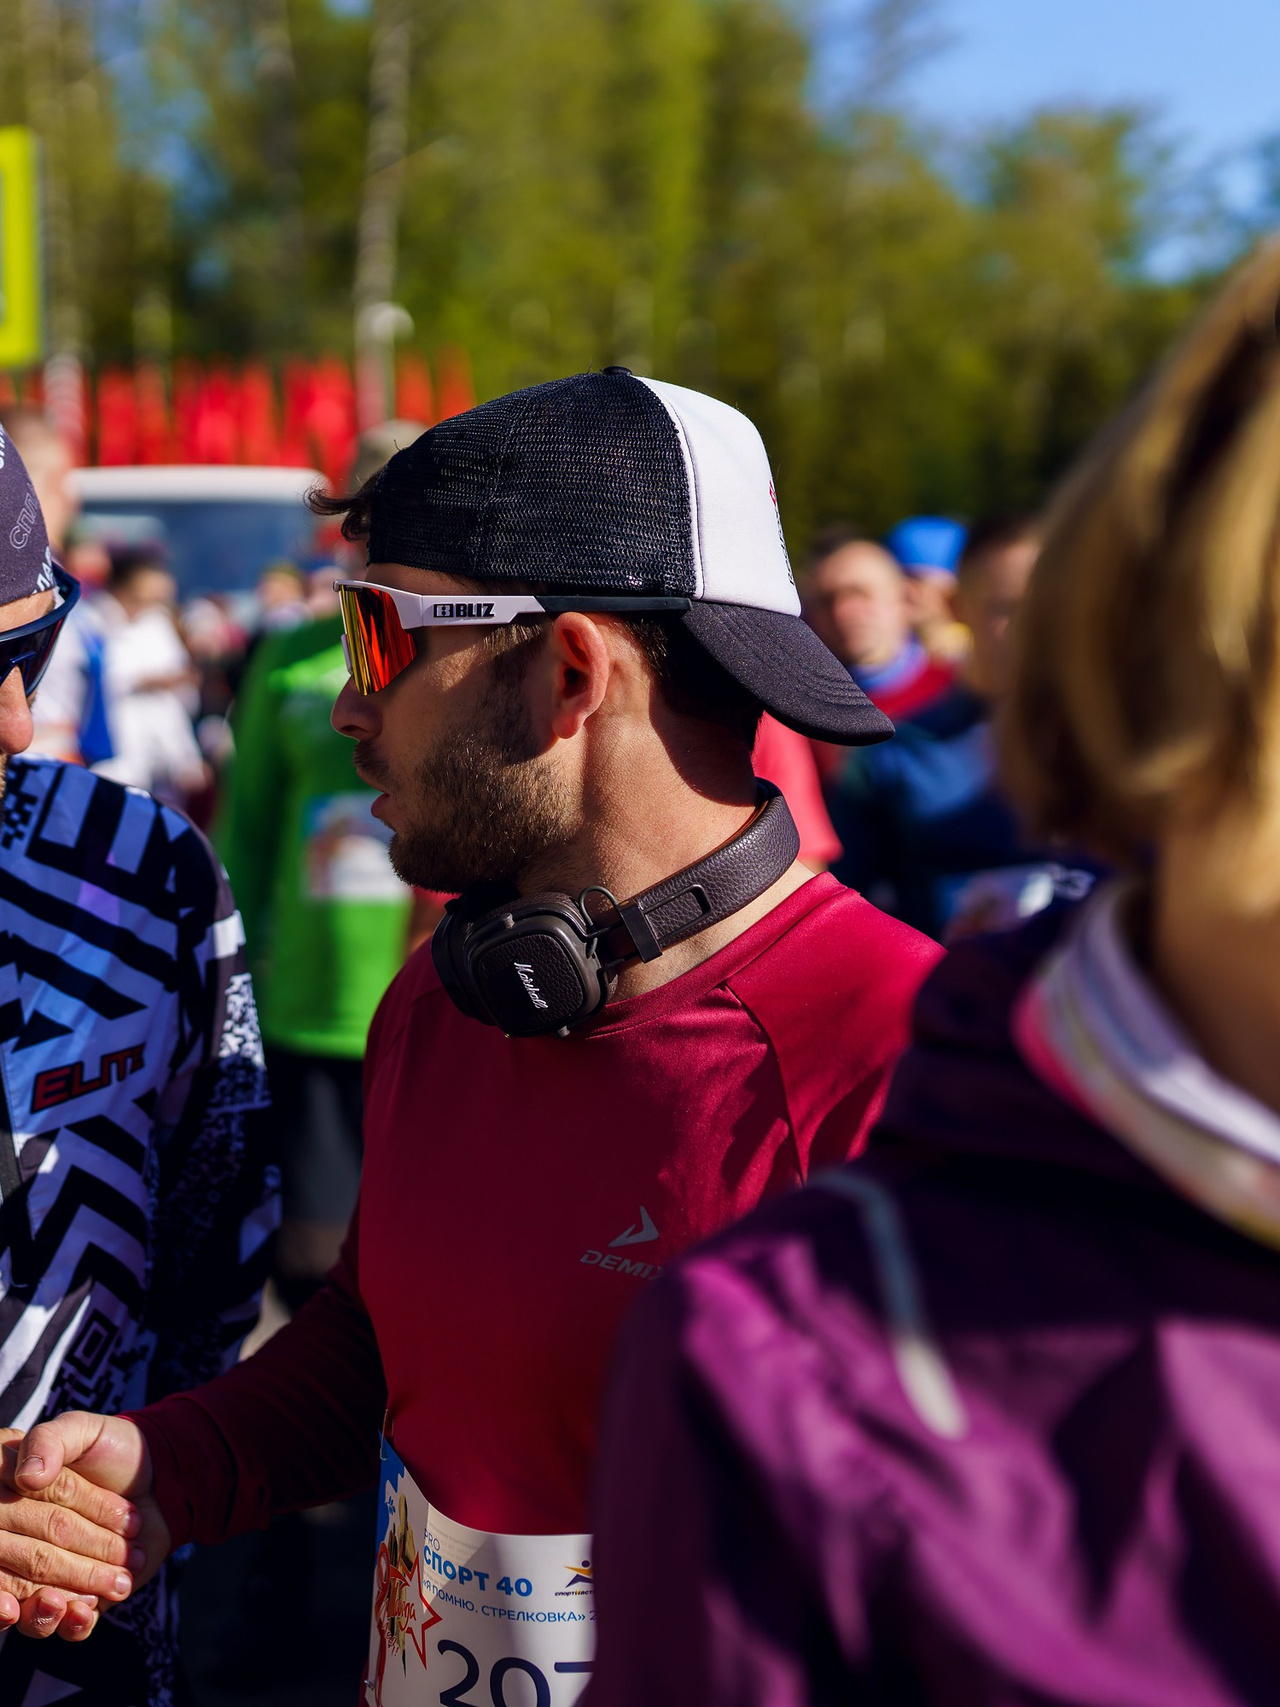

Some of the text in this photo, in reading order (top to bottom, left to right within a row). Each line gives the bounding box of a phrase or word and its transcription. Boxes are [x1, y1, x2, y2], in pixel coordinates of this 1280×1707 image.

[9, 482, 39, 549] СПЛ
[456, 603, 495, 617] BLIZ
[513, 962, 549, 1009] Marshall
[424, 1528, 440, 1551] PRO
[423, 1545, 532, 1597] СПОРТ 40
[432, 1585, 478, 1613] ПОМНЮ.
[481, 1605, 586, 1623] СТРЕЛКОВКА»
